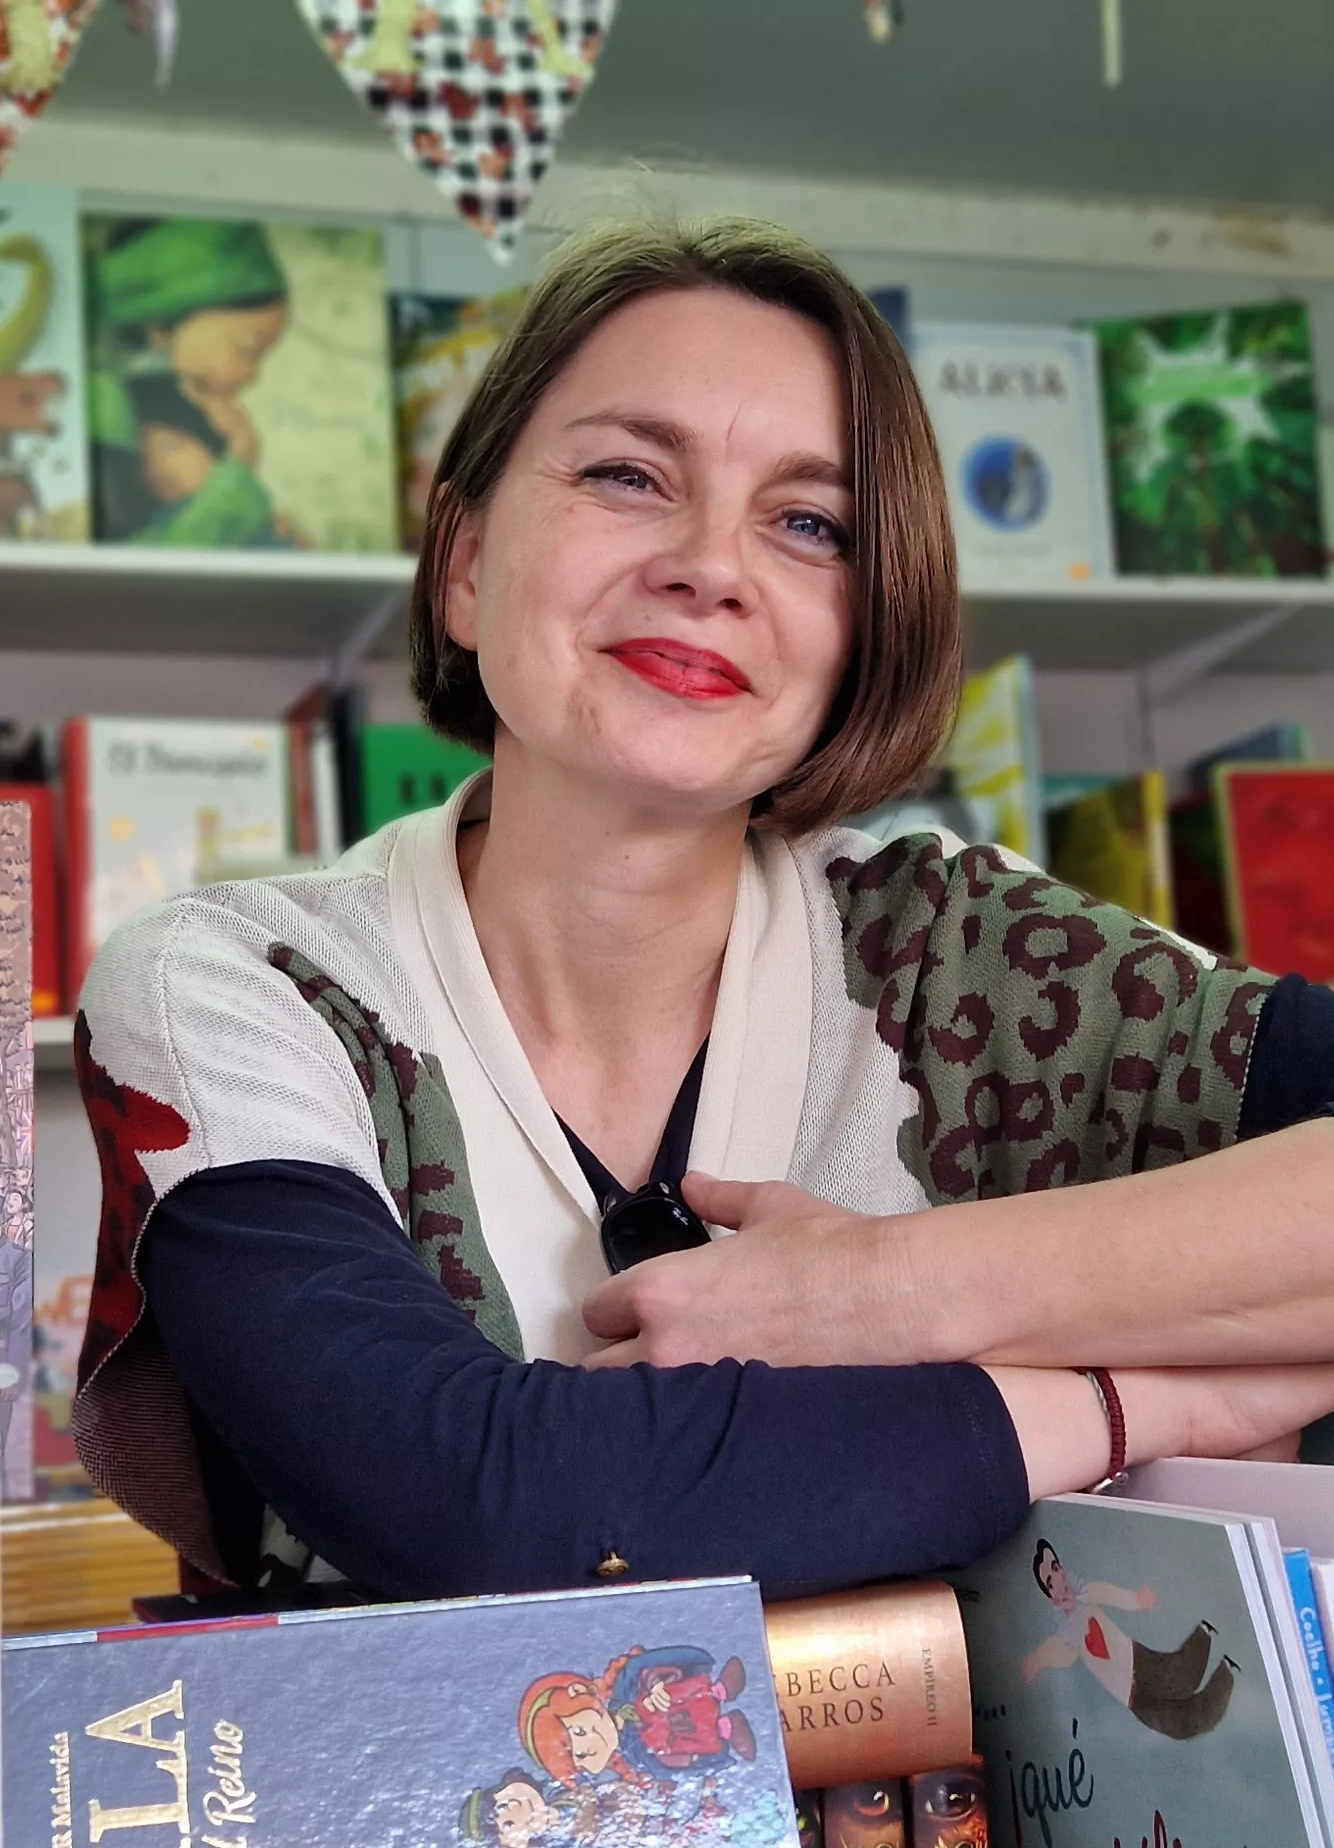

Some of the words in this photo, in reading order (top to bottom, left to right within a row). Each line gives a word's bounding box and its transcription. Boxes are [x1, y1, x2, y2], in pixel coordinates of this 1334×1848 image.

[1299, 1607, 1326, 1671] Coelho
[773, 1660, 895, 1698] BECCA
[921, 1648, 940, 1717] EMPÍREO
[85, 1680, 191, 1848] LA
[202, 1719, 256, 1825] Reino
